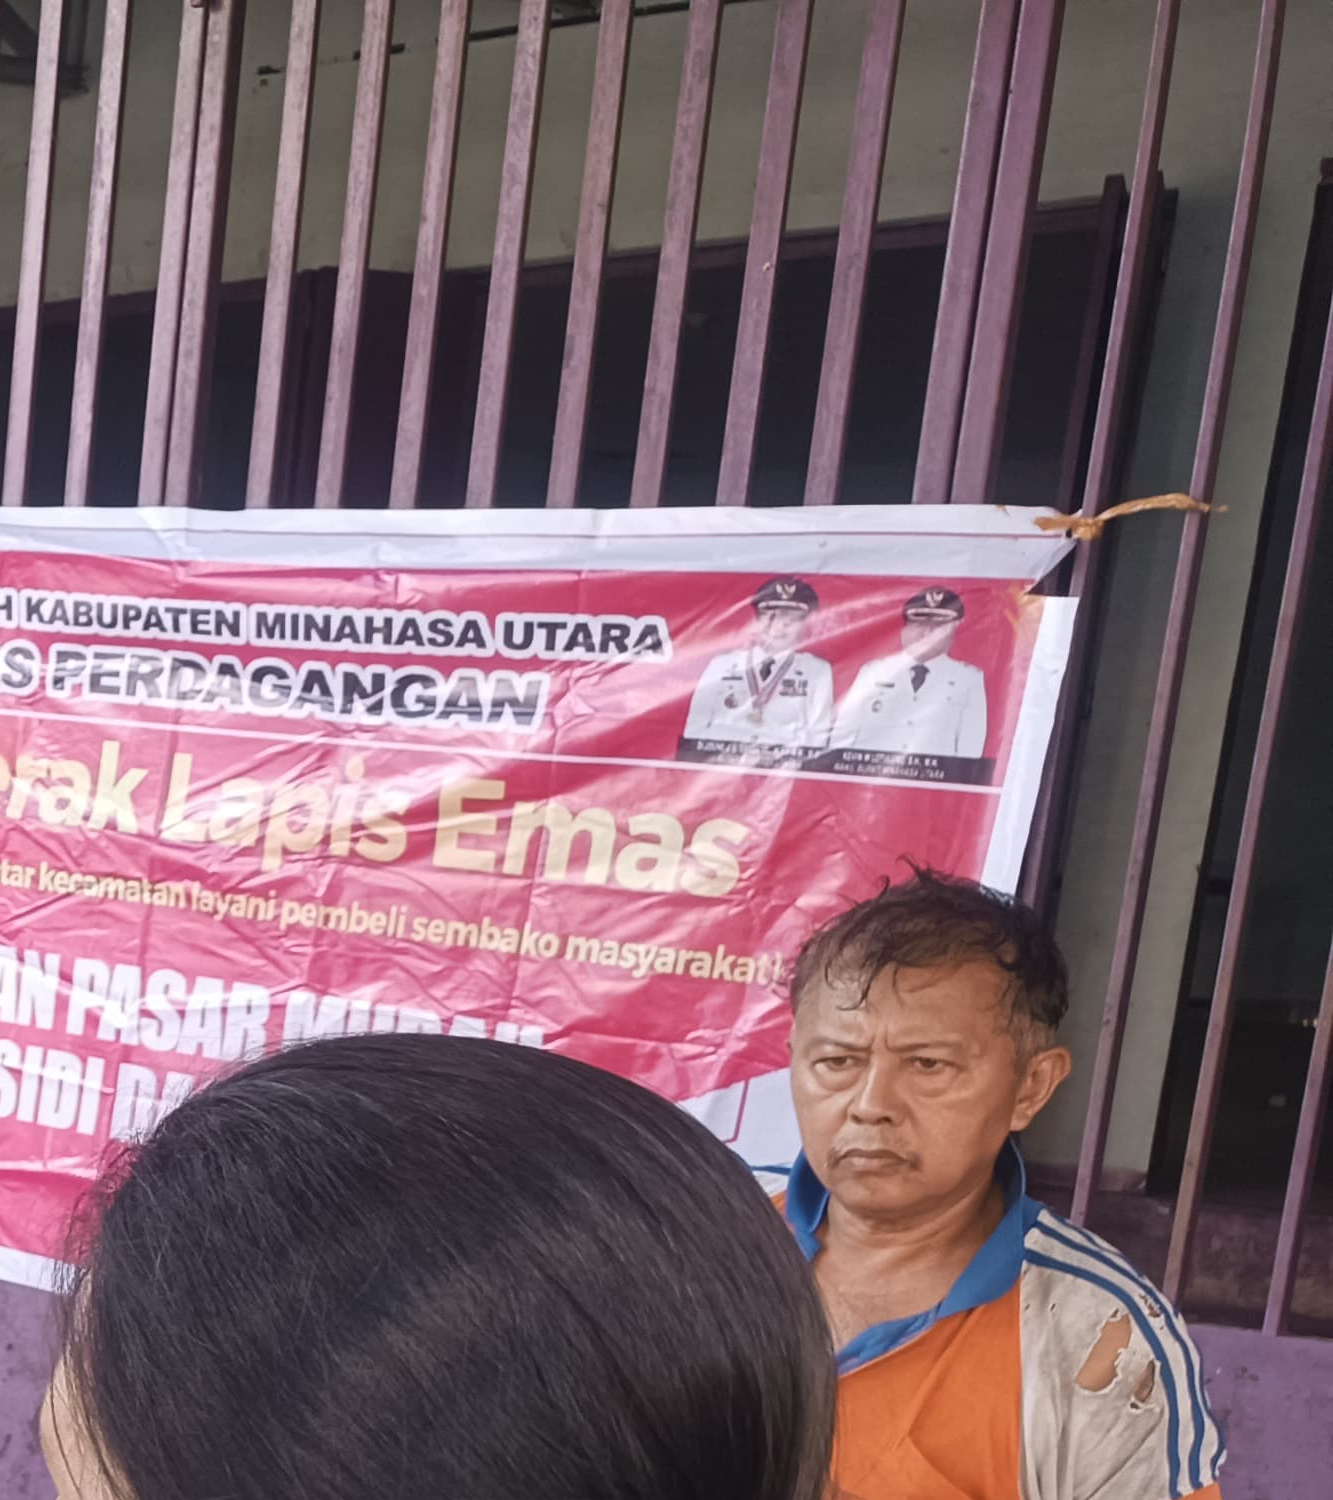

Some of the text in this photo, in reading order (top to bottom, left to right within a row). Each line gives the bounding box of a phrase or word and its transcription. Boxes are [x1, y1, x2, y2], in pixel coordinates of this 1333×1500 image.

[25, 595, 241, 639] KABUPATEN
[255, 611, 487, 649] MINAHASA
[503, 619, 665, 656] UTARA
[52, 649, 543, 725] PERDAGANGAN
[155, 751, 407, 871] Lapis
[432, 777, 750, 897] Emas
[38, 861, 184, 909] kecamatan
[190, 881, 276, 921] layani
[279, 898, 408, 938] pembeli
[410, 915, 560, 960] sembako
[67, 957, 270, 1063] PASAR
